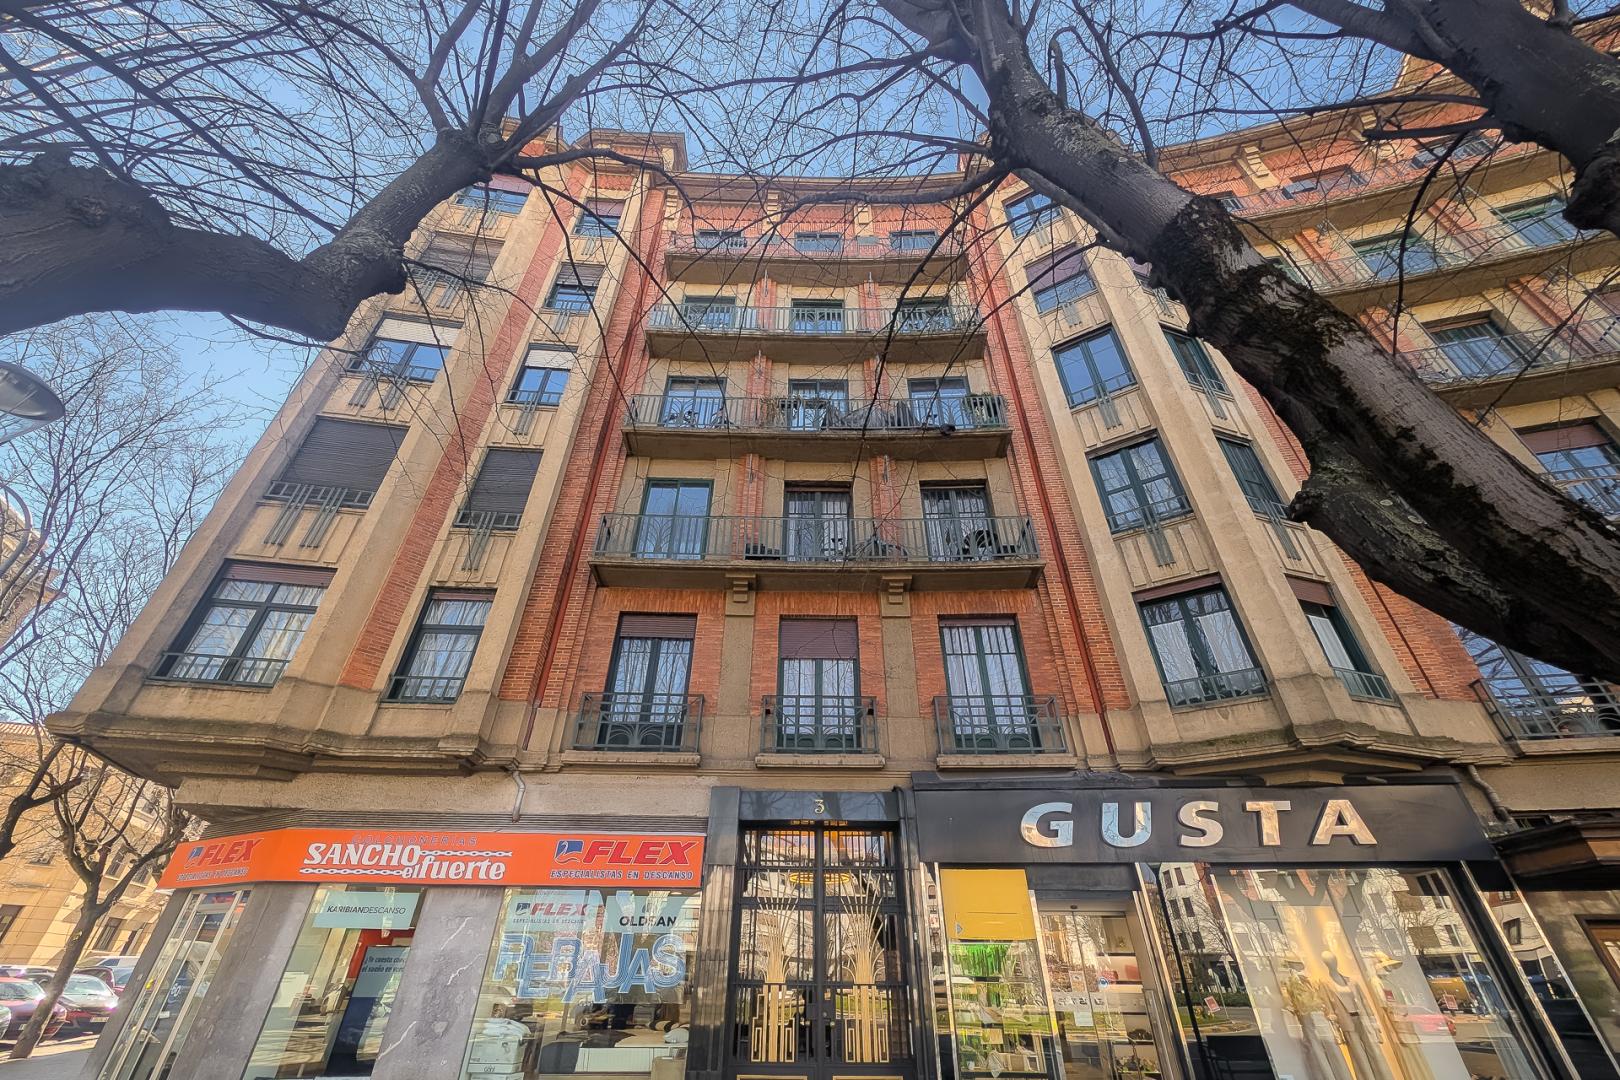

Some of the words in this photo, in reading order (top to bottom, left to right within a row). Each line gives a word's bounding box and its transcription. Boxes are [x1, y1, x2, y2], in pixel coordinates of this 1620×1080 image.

[813, 799, 825, 814] 3
[1019, 799, 1379, 849] GUSTA
[197, 837, 264, 867] FLEX
[303, 843, 421, 867] SANCHO
[582, 839, 699, 866] FLEX
[418, 855, 506, 880] fuerte
[550, 869, 623, 880] ESPECIALISTAS
[626, 871, 640, 880] EN
[643, 871, 694, 880] DESCANSO
[530, 902, 589, 916] FLEX
[493, 932, 687, 1004] REBAJAS
